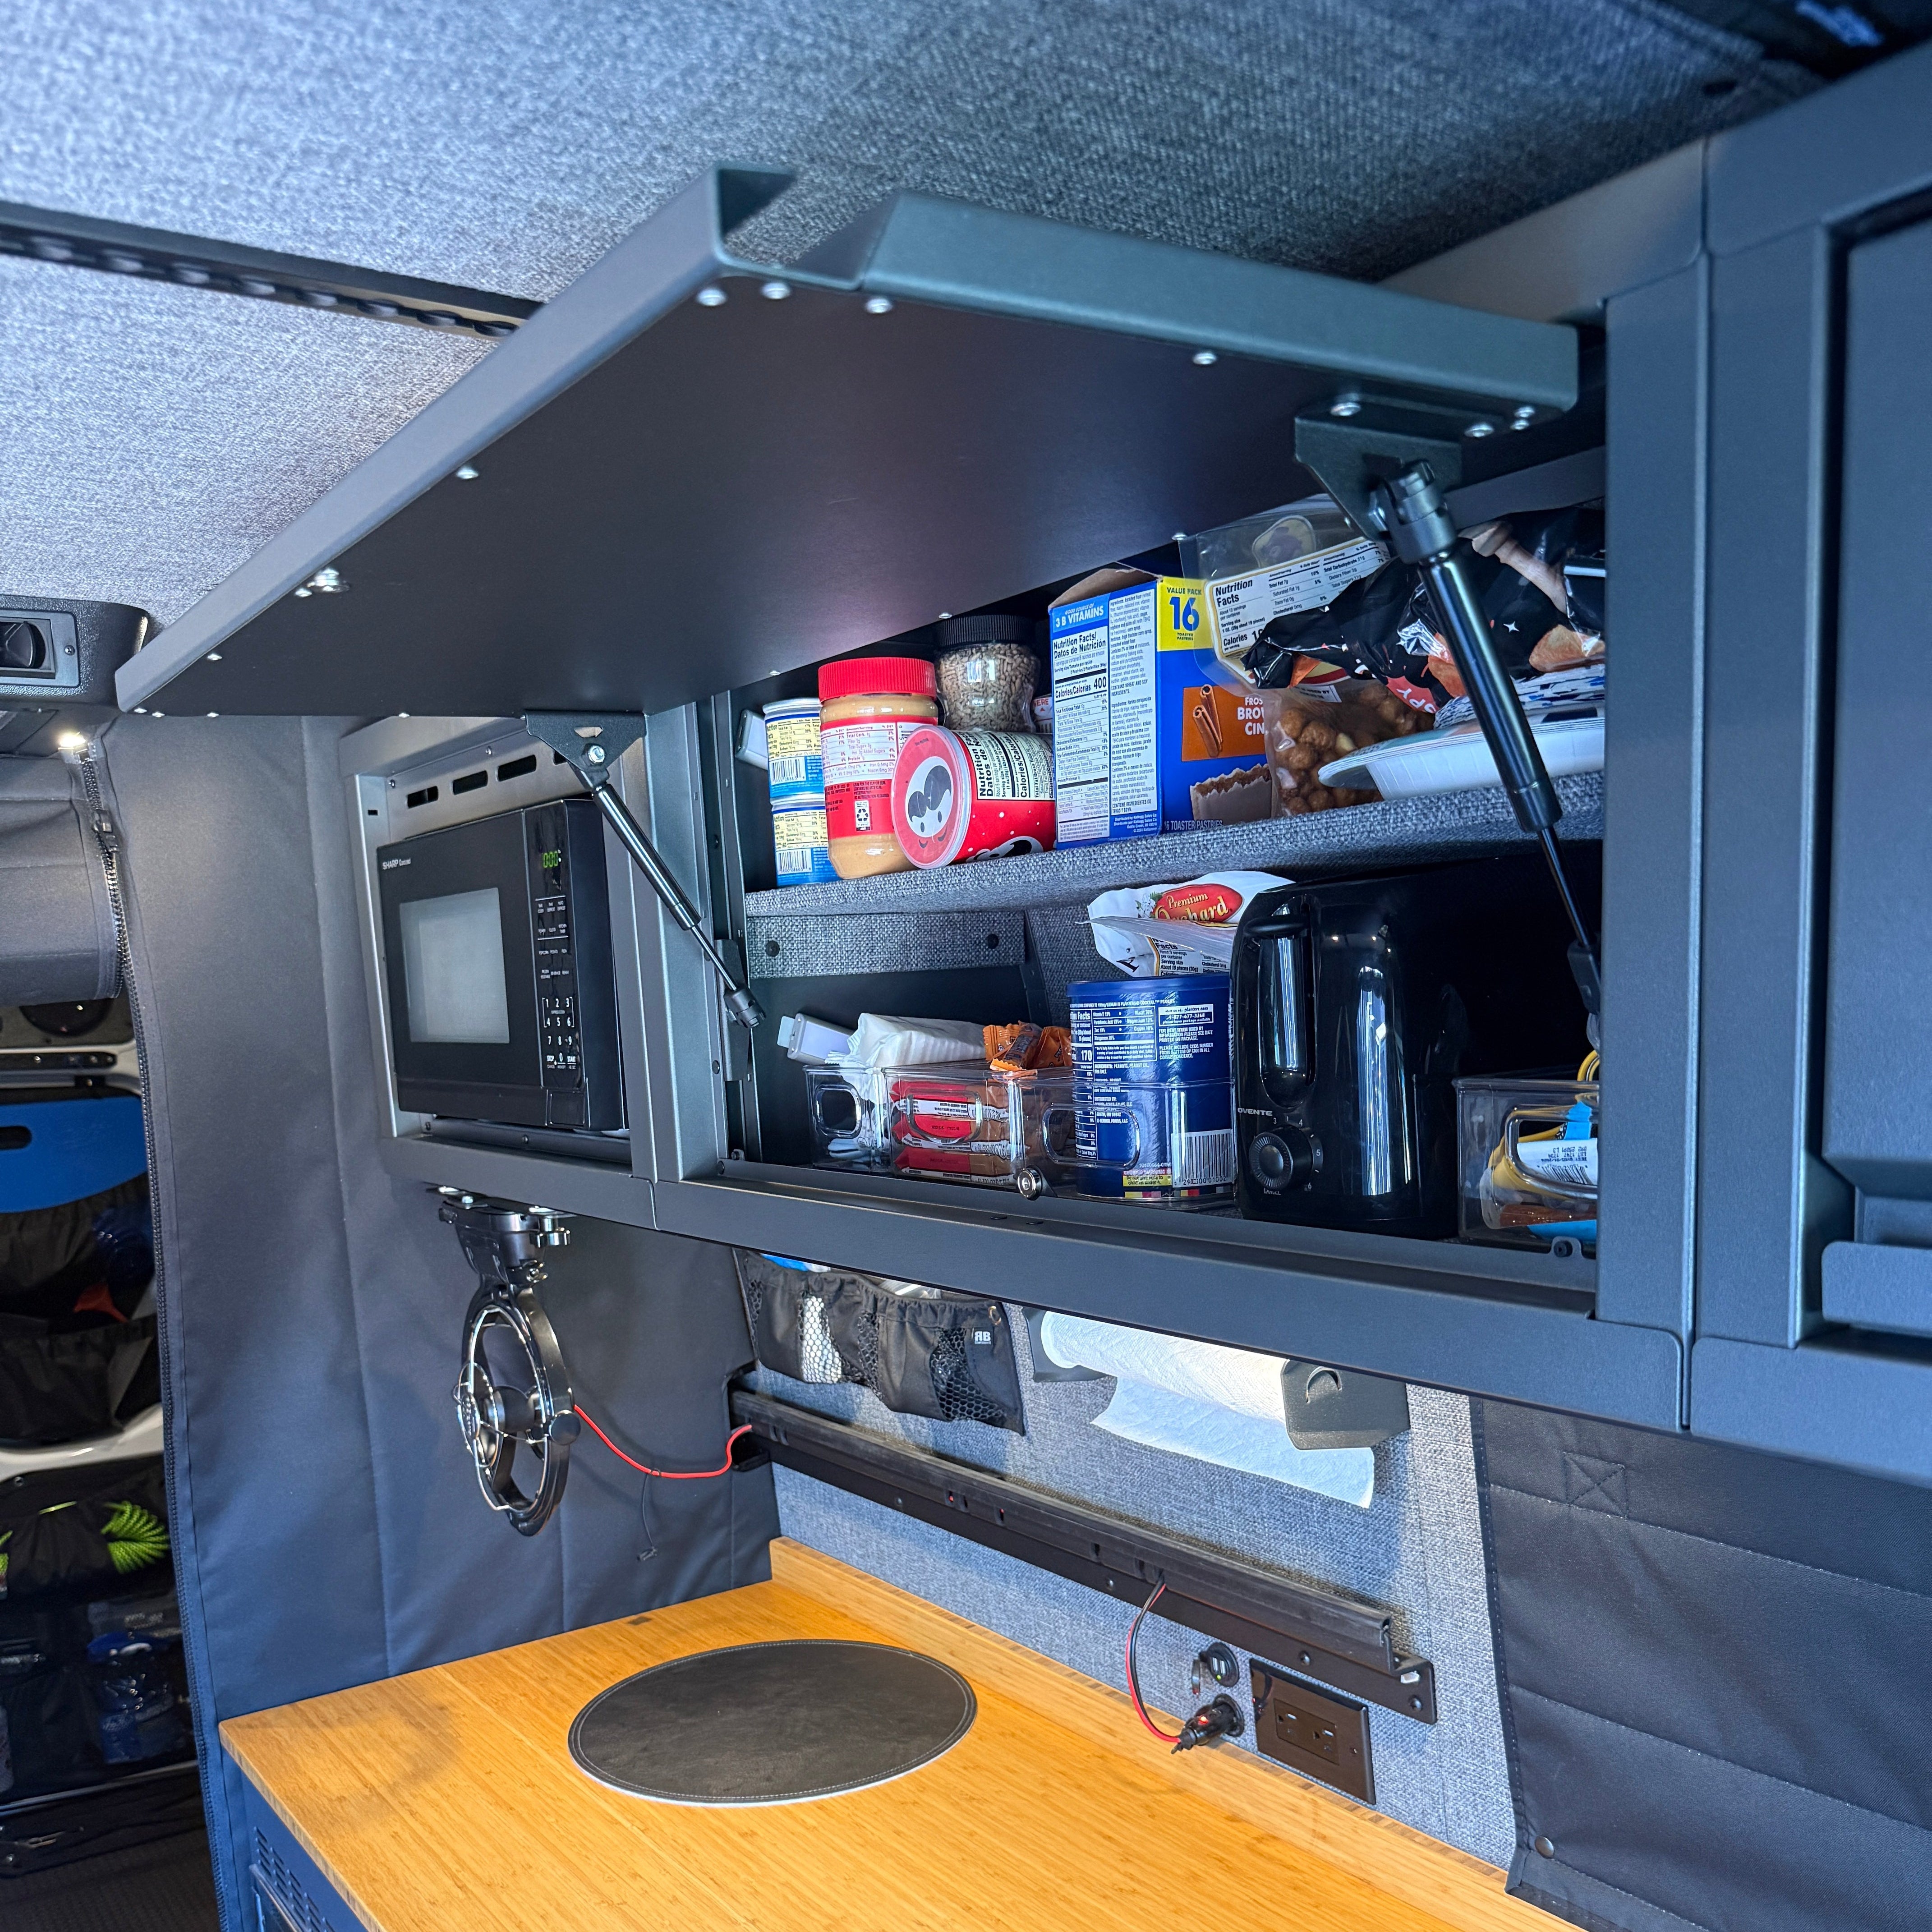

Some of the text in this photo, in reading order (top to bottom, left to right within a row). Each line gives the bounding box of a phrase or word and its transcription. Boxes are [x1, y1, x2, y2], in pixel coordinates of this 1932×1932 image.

[1215, 580, 1253, 597] Nutrition
[1217, 594, 1239, 607] Facts
[1056, 605, 1104, 627] 3 B VITAMINS
[1169, 596, 1199, 631] 16
[1054, 631, 1097, 650] Nutrition Facts/
[1224, 634, 1247, 646] Calories
[1054, 639, 1106, 659] Datos de Nutrición
[1094, 676, 1106, 689] 400
[972, 749, 986, 796] Nutrition
[980, 749, 993, 796] Datos de
[1171, 820, 1195, 831] TOASTER
[1196, 820, 1223, 830] PASTRIES
[382, 859, 398, 869] SHARP
[1167, 893, 1209, 910] Premium
[546, 998, 570, 1008] 1 2 3
[547, 1017, 570, 1027] 4 5 6
[1077, 1012, 1090, 1020] Facts
[548, 1036, 572, 1045] 7 8 9
[559, 1053, 563, 1062] 0
[1081, 1050, 1092, 1061] 170
[1237, 1108, 1273, 1116] OVENTE
